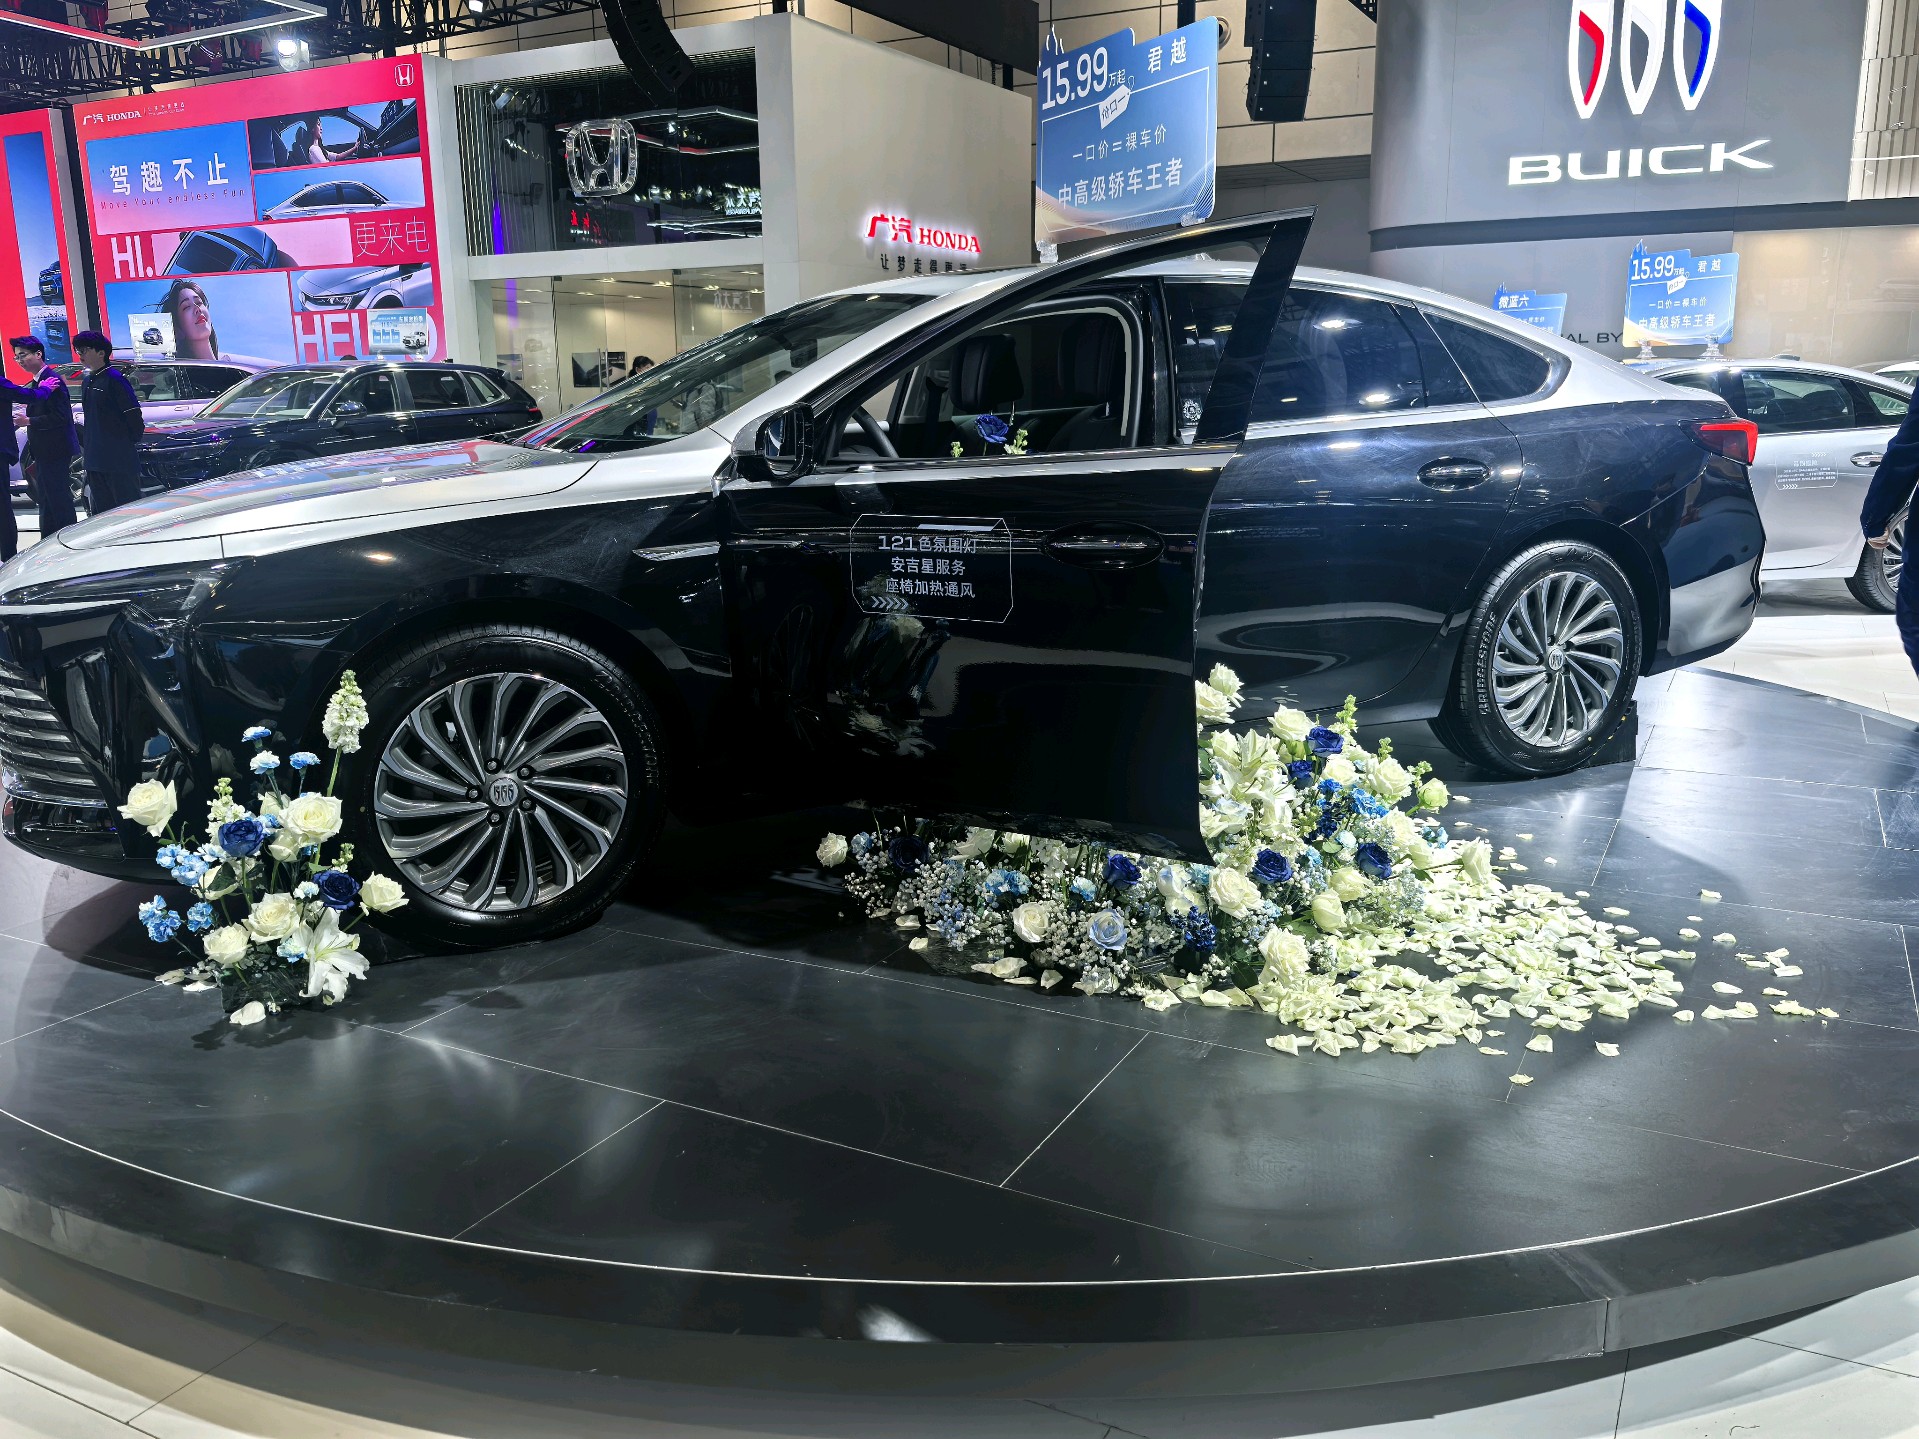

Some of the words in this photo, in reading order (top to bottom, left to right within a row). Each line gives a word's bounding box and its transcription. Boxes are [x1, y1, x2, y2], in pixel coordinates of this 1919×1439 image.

[1148, 36, 1187, 74] 君越
[83, 113, 105, 126] 广汽
[106, 110, 142, 122] HONDA
[1072, 123, 1167, 161] 一口价=裸车价
[109, 152, 229, 196] 驾趣不止
[1508, 139, 1774, 186] BUICK
[1058, 157, 1183, 210] 中高级轿车王者
[134, 197, 160, 207] Your
[354, 215, 430, 258] 更来电
[868, 213, 913, 244] 广汽
[918, 227, 982, 254] HONDA
[110, 235, 154, 279] HI.
[1697, 258, 1722, 273] 君越
[1639, 313, 1716, 330] 中高级轿车王者
[1597, 332, 1623, 344] BY
[878, 535, 977, 554] 121色氛围灯
[891, 556, 966, 576] 安吉星服务
[885, 577, 976, 599] 座椅加热通风
